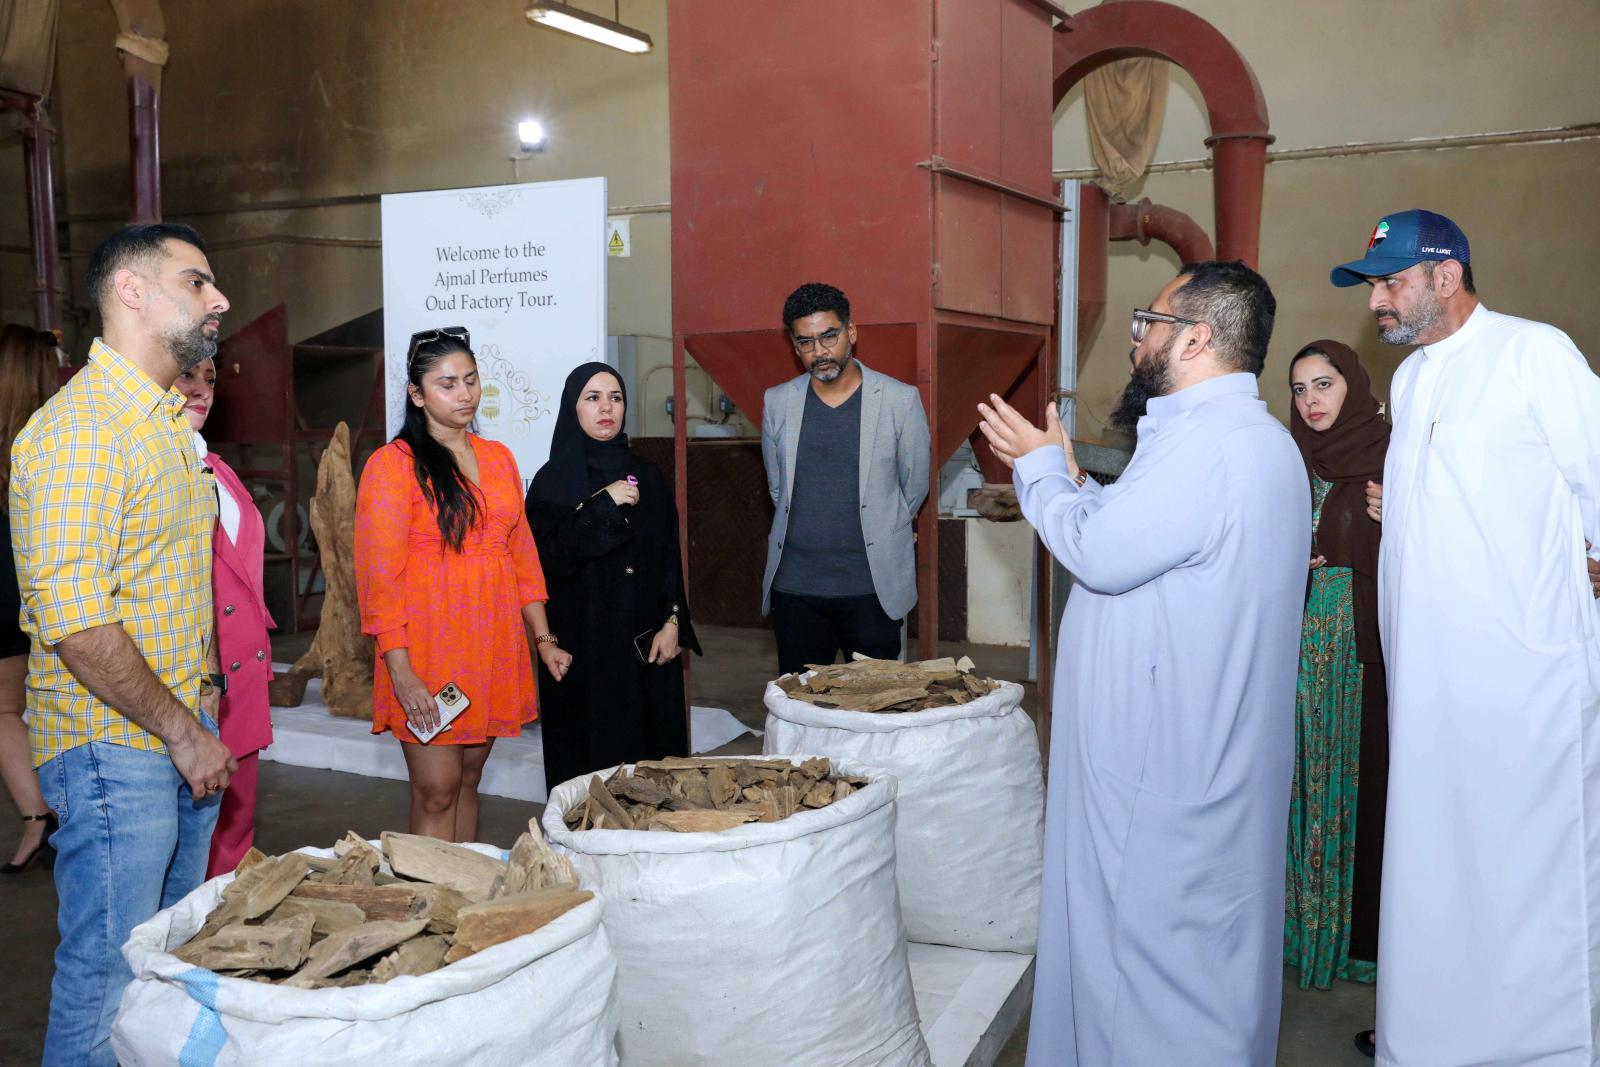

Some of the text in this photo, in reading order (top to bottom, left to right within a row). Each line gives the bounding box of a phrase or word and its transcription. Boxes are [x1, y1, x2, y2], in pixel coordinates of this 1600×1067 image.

[436, 241, 546, 262] Welcome to the
[434, 267, 548, 291] Ajmal Perfumes
[425, 291, 557, 314] Oud Factory Tour.
